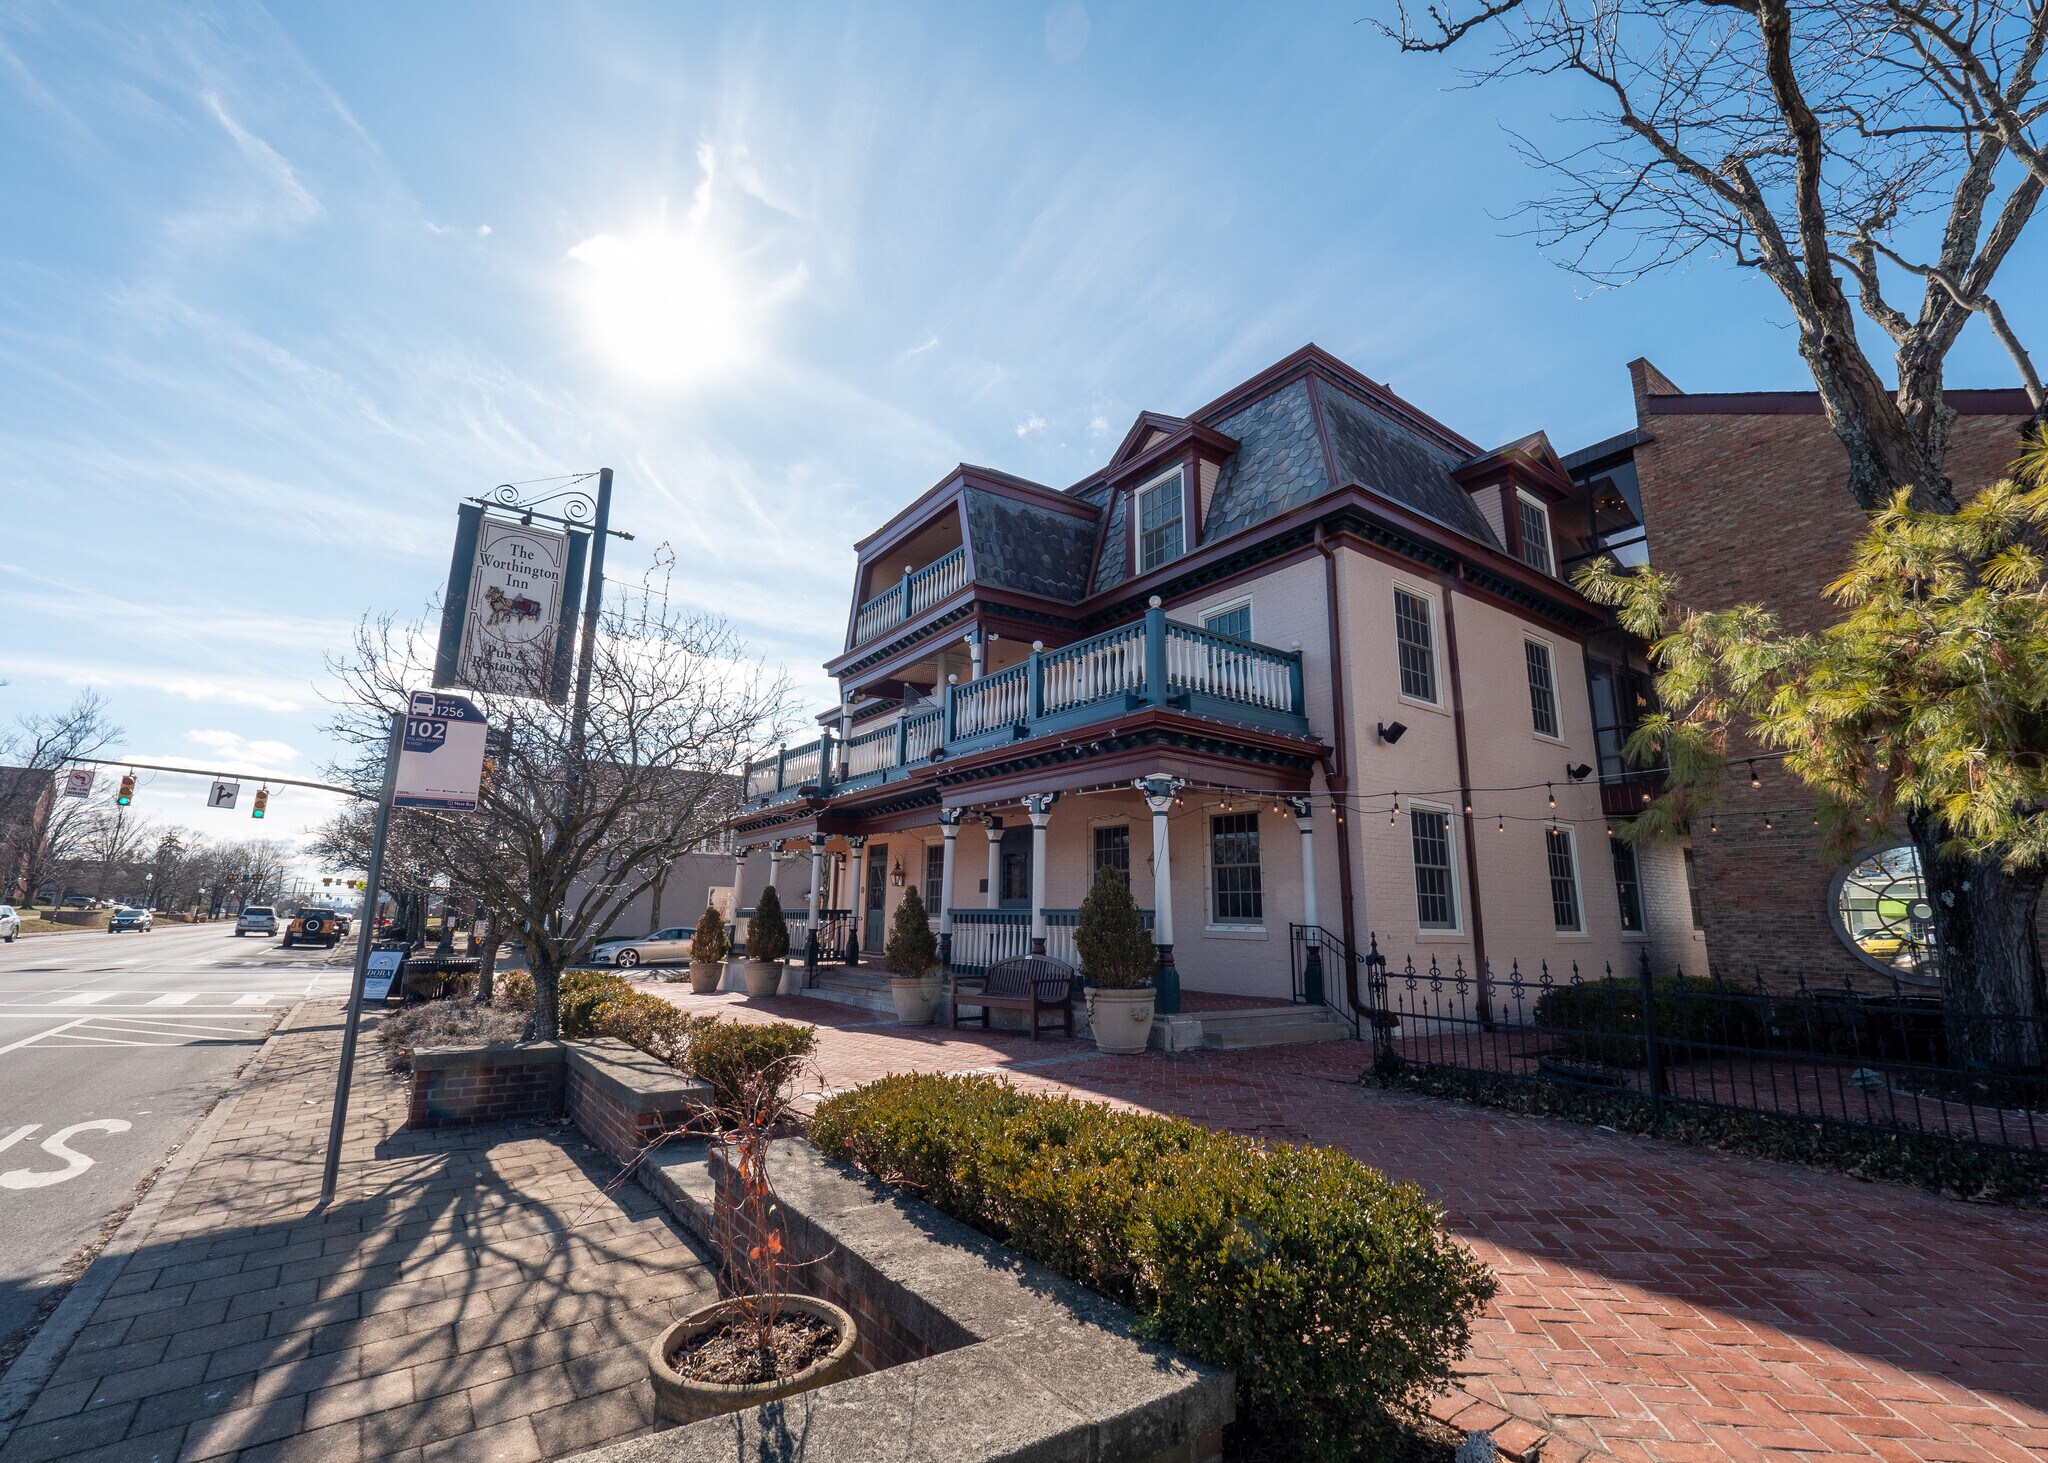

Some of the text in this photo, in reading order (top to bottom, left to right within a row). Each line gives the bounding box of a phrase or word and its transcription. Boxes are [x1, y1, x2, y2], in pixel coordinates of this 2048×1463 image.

[510, 543, 535, 560] The
[480, 552, 559, 581] Worthington
[505, 573, 529, 590] Inn
[487, 644, 512, 660] Pub
[471, 655, 539, 677] Restaurant
[437, 706, 464, 718] 1256
[410, 721, 445, 738] 102
